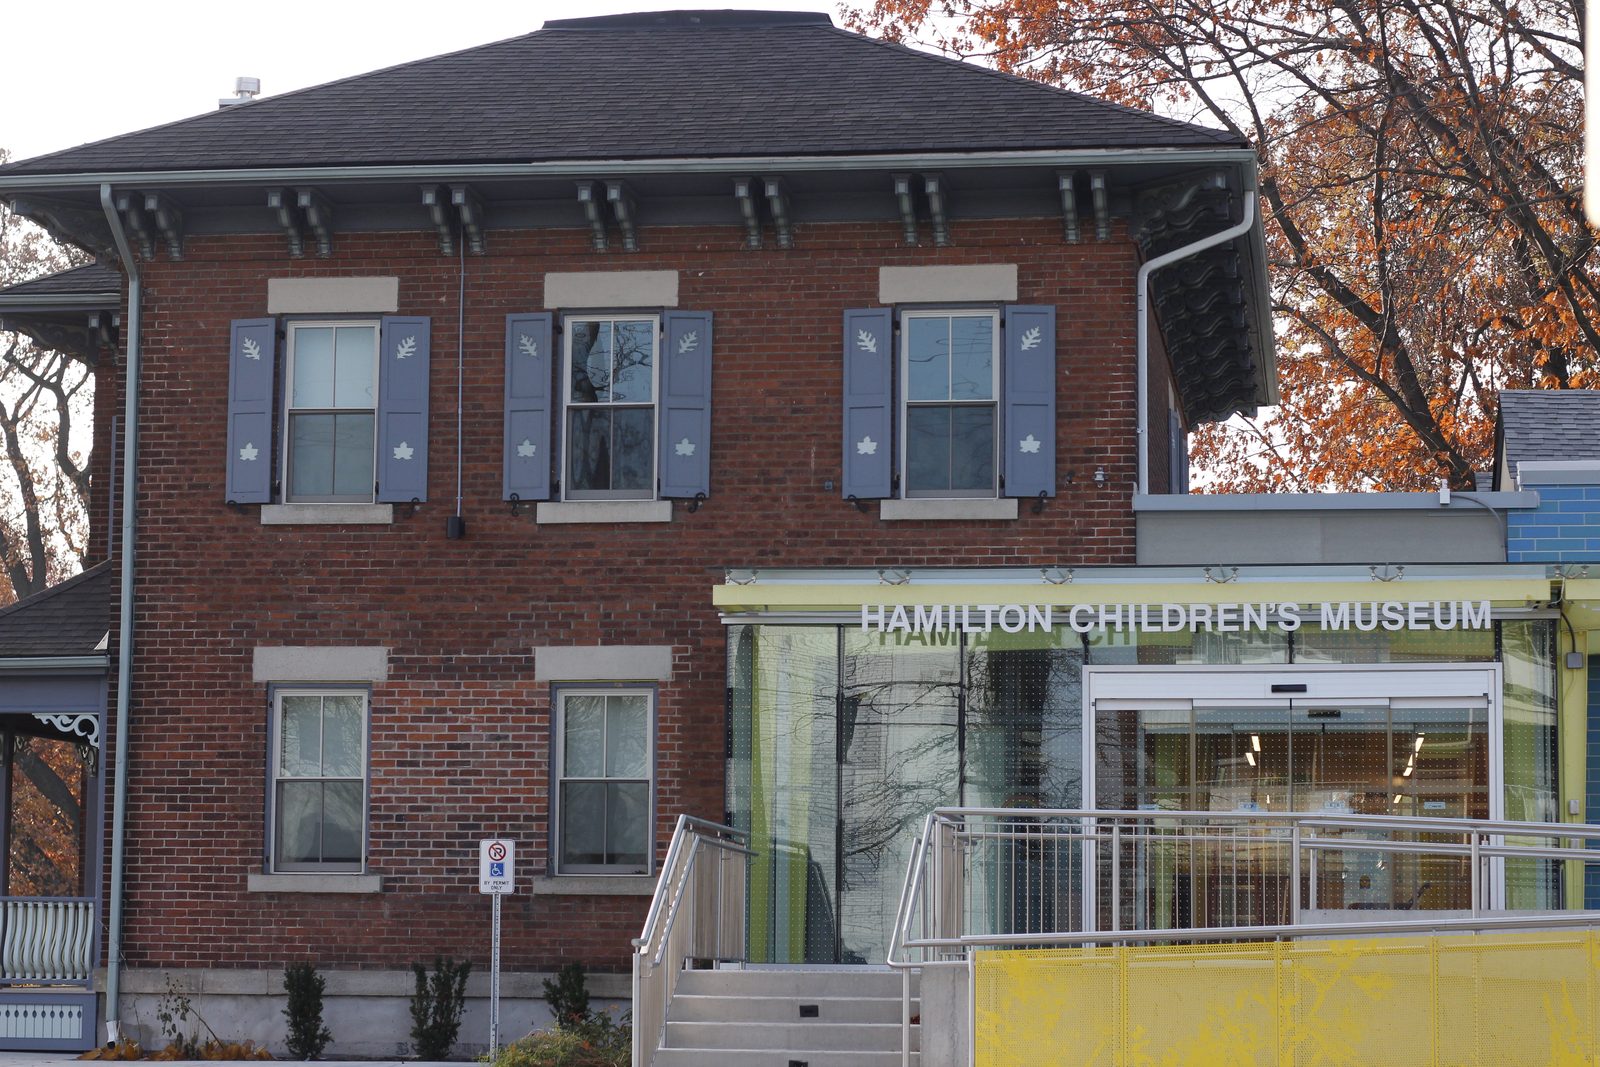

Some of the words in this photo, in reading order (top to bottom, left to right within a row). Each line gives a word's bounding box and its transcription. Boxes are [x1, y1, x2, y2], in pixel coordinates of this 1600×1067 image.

[861, 604, 1052, 633] HAMILTON
[1069, 602, 1301, 633] CHILDREN'S
[1320, 600, 1492, 631] MUSEUM
